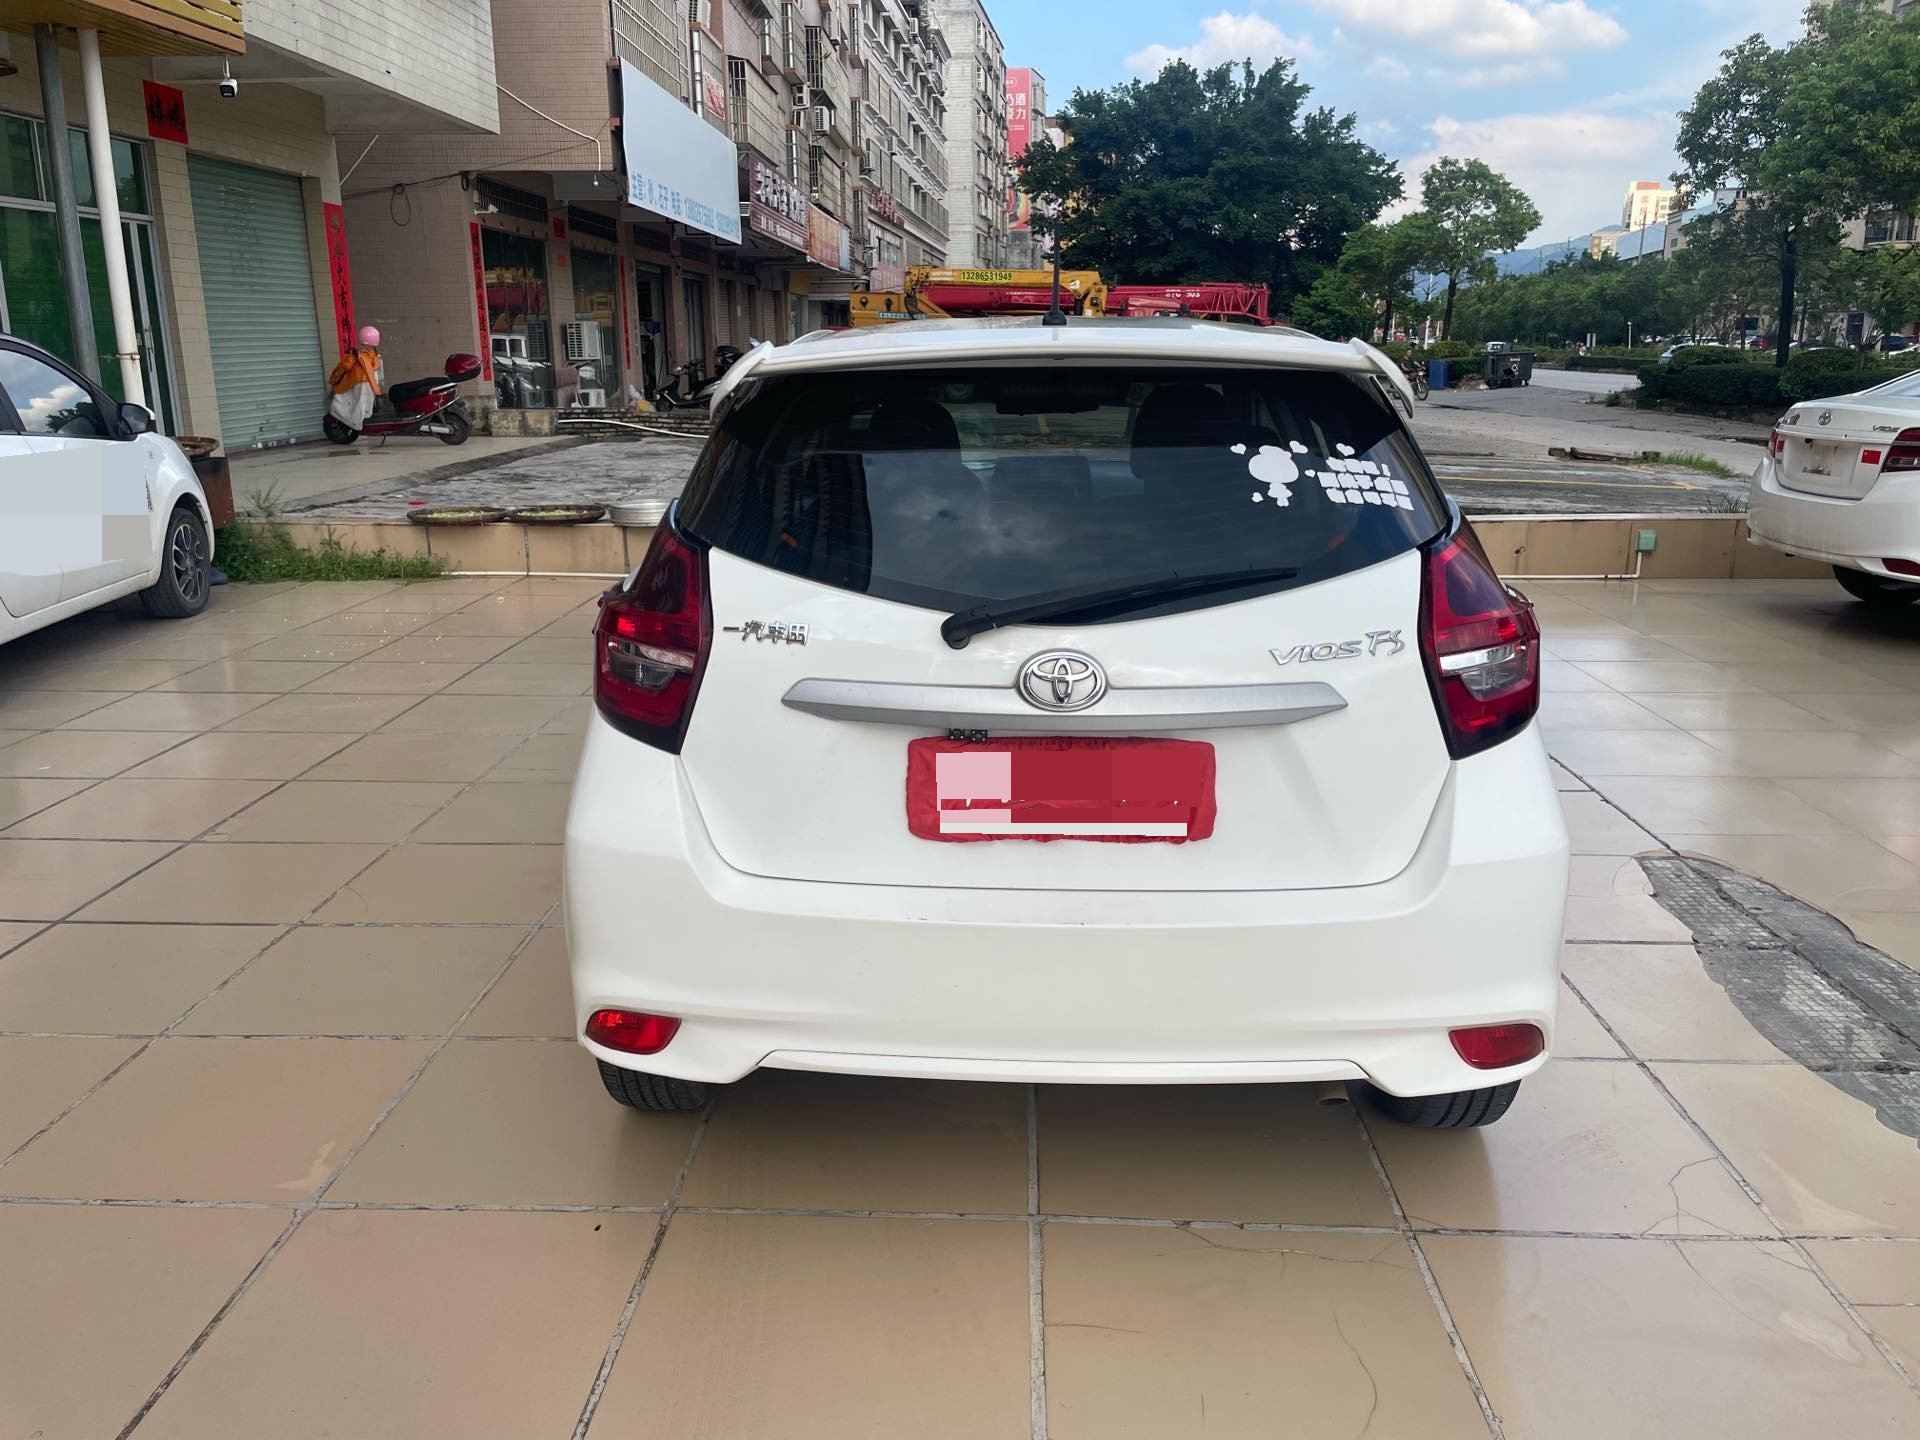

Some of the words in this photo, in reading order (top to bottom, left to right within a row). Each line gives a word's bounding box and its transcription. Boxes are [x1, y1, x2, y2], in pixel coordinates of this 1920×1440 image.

[962, 271, 1012, 281] 13286531949
[723, 620, 810, 646] 一汽丰田
[1269, 640, 1362, 665] VIOS
